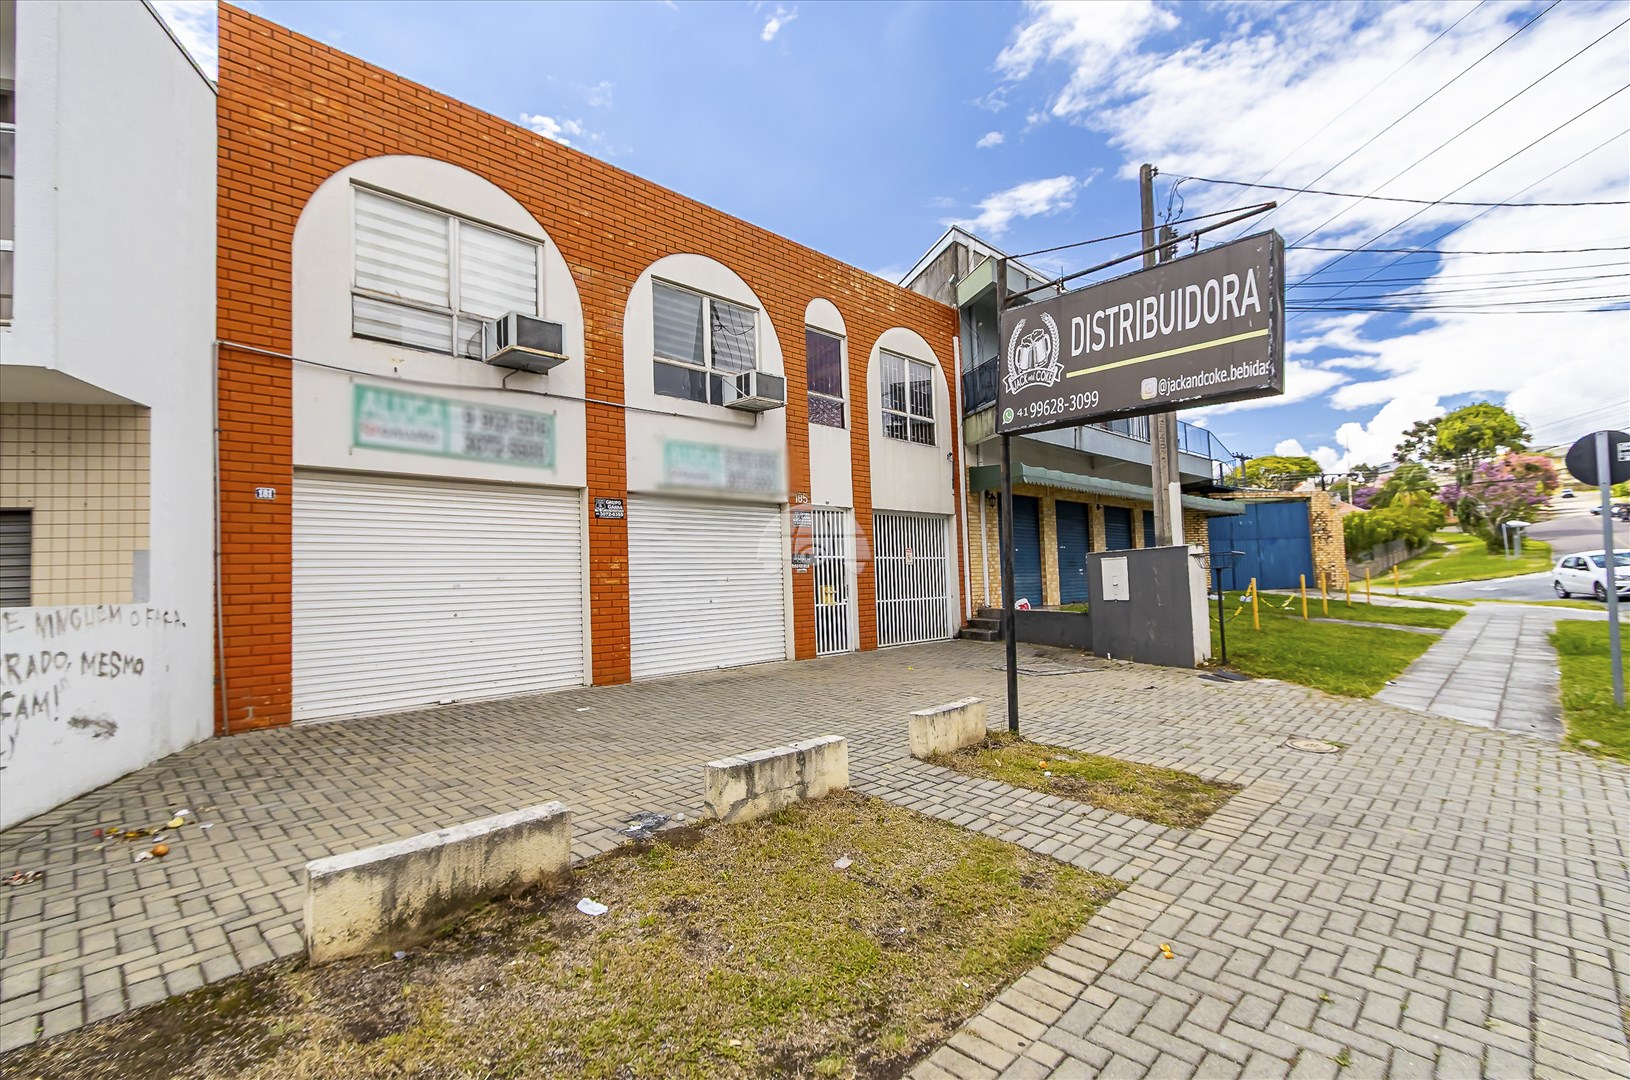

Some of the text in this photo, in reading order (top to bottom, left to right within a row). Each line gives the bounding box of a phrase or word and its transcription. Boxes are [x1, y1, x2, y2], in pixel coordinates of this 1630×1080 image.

[1071, 268, 1261, 357] DISTRIBUIDORA
[1013, 373, 1028, 391] JACK
[1036, 370, 1053, 383] COKE
[1158, 360, 1272, 396] @jackandcoke.bebidas
[1017, 391, 1099, 418] 41 99628-3099
[795, 494, 809, 503] 185
[80, 650, 144, 679] MESMO
